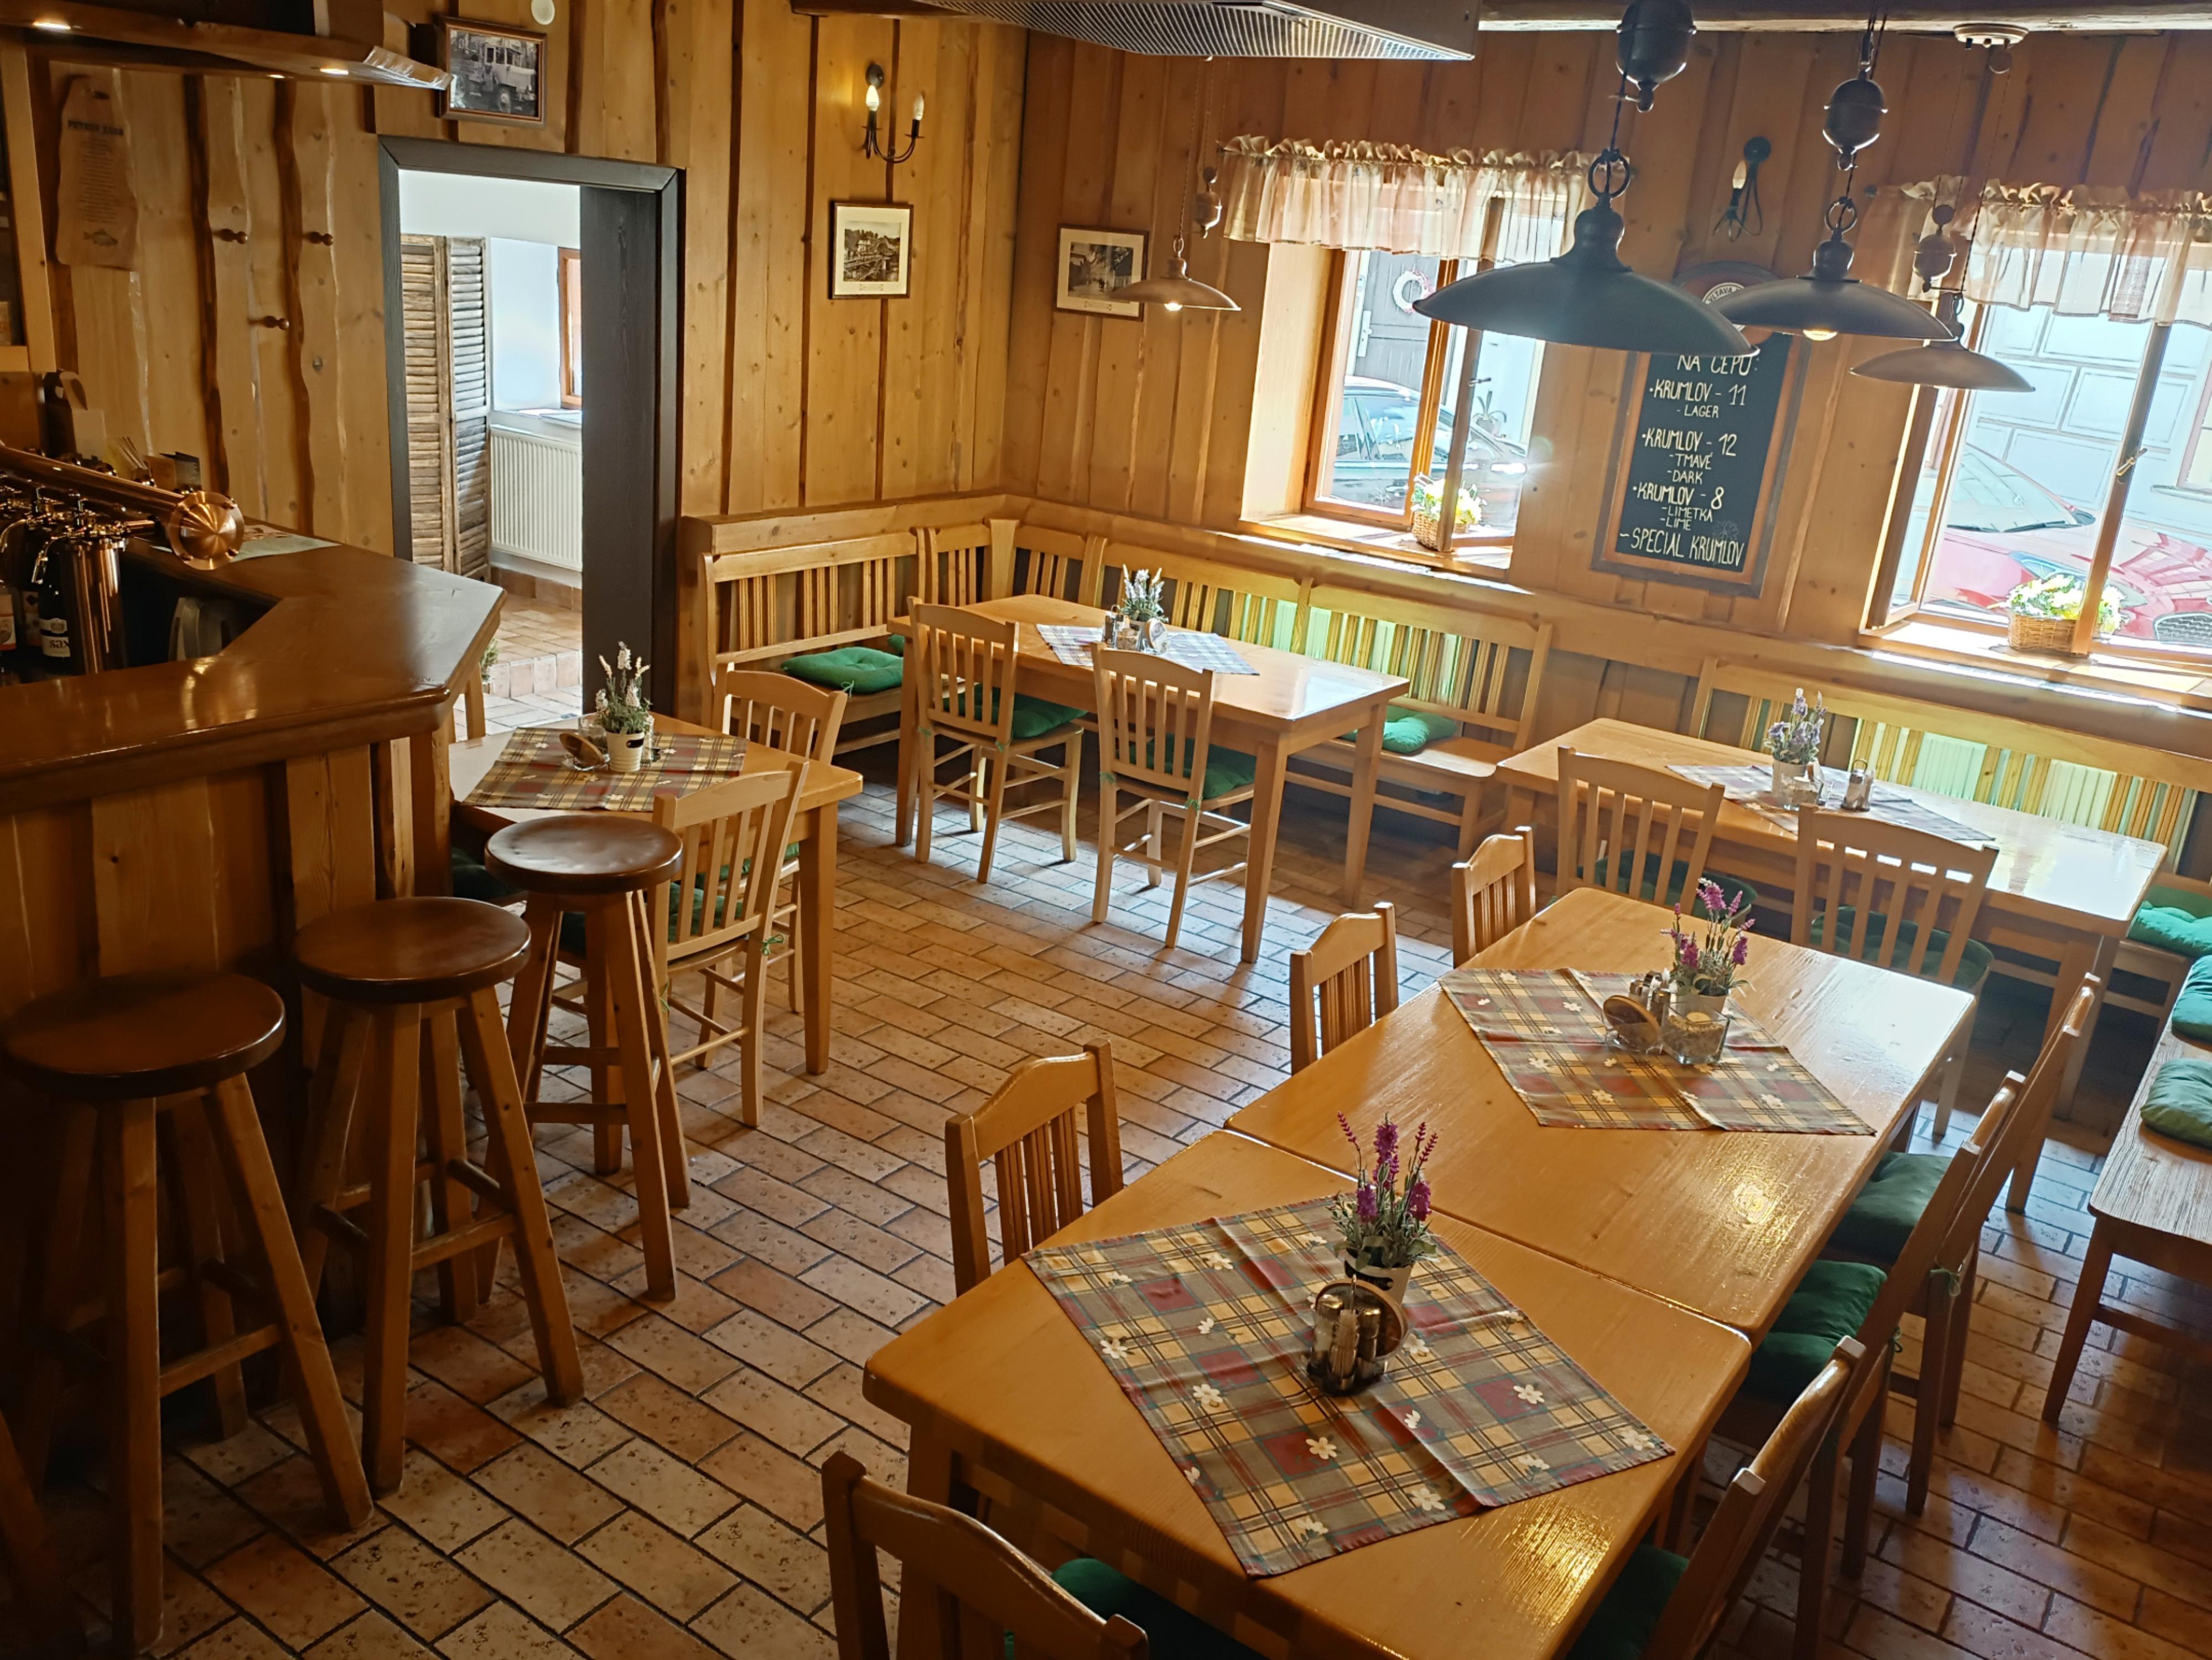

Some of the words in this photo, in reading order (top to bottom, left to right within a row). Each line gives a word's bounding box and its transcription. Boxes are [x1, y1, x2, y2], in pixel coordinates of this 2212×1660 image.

[1677, 355, 1700, 372] NA
[1653, 378, 1713, 402] KRUMLOV
[1728, 383, 1747, 406] 11
[1684, 404, 1719, 418] LAGER
[1718, 433, 1737, 456] 12
[1637, 482, 1695, 506] KRUMLOV
[1711, 486, 1724, 510] 8
[1689, 535, 1744, 567] KRUMLOV
